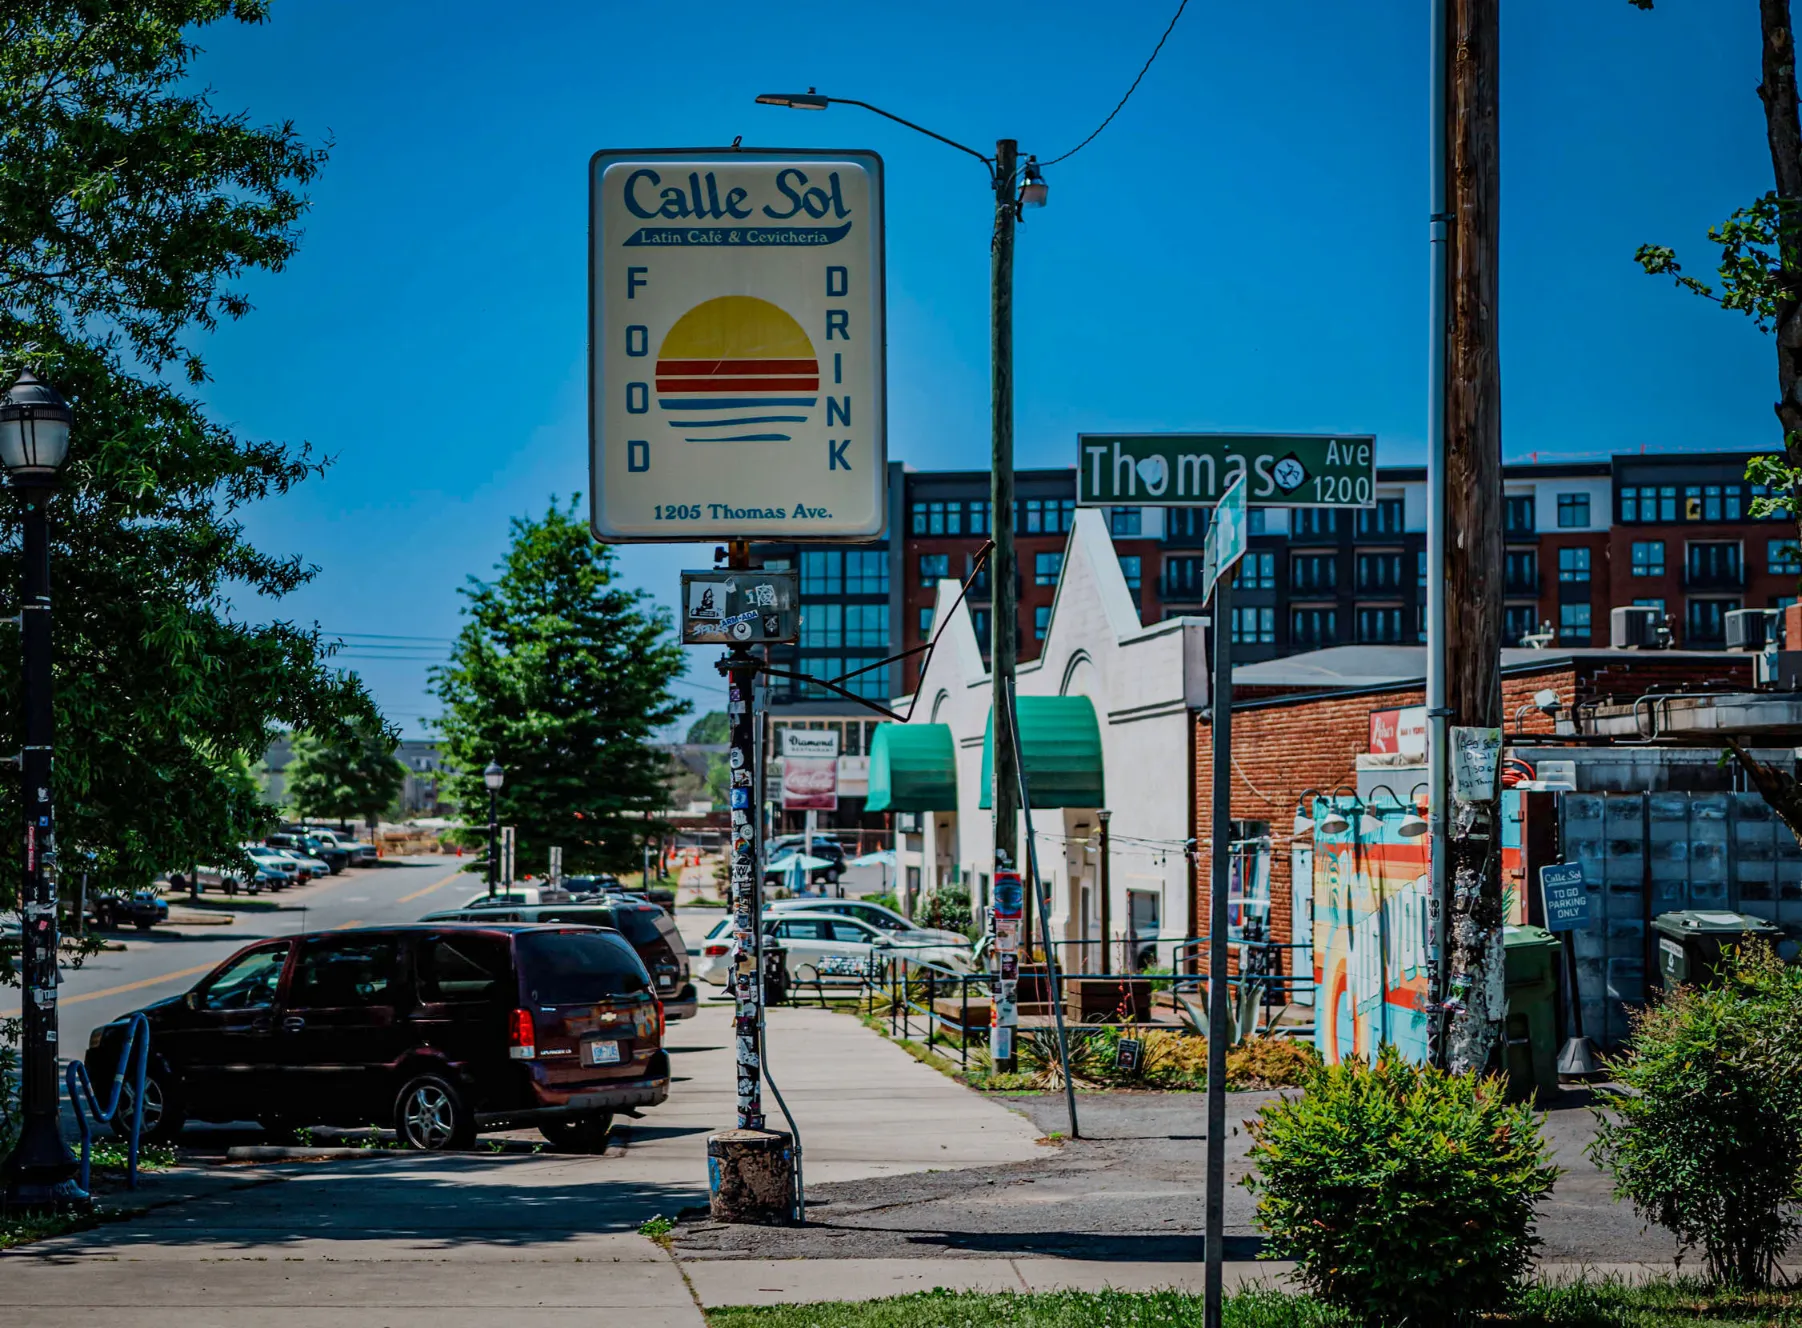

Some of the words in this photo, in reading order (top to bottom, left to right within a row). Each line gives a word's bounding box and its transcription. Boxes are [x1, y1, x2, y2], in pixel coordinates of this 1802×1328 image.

[623, 168, 753, 220] Calle
[762, 168, 852, 219] Sol
[640, 230, 682, 244] Latin
[687, 229, 723, 244] Café
[728, 231, 741, 243] &
[625, 266, 650, 473] FOOD
[826, 265, 852, 472] DRINK
[1325, 440, 1370, 466] Ave
[1313, 475, 1370, 502] 1200
[654, 504, 702, 521] 1205
[707, 503, 787, 521] Thomas
[792, 503, 834, 520] Ave.
[1545, 874, 1566, 883] Calle
[1568, 870, 1582, 880] Sol
[1553, 889, 1565, 899] TO
[1566, 887, 1579, 897] GO
[1548, 896, 1587, 910] PARKING
[1557, 907, 1580, 919] ONLY
